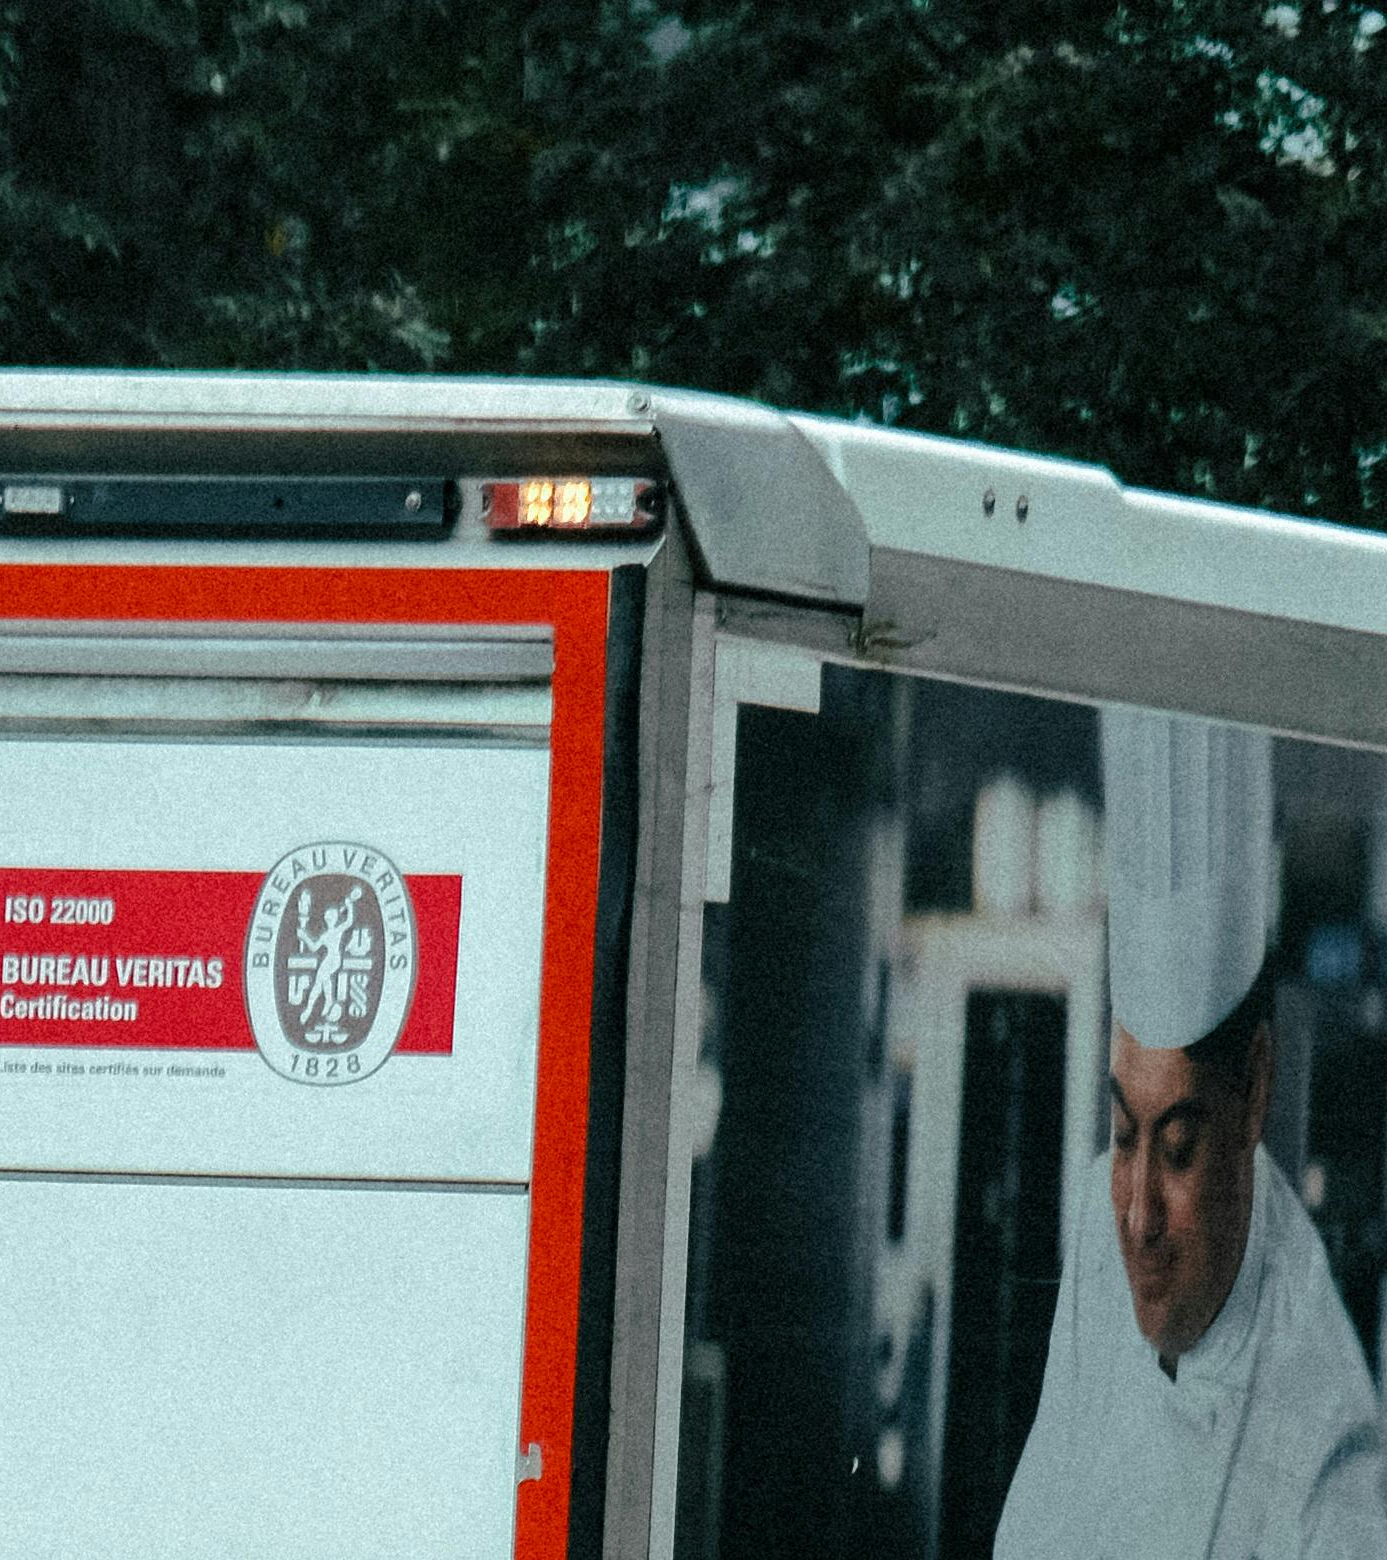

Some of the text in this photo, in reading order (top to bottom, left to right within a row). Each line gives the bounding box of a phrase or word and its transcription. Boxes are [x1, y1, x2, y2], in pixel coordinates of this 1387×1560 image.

[4, 896, 114, 926] ISO 22000
[252, 849, 408, 971] BUREAU VERITAS
[1, 956, 224, 989] BUREAU VERITAS
[0, 994, 137, 1022] Certification
[30, 1061, 53, 1074] des
[290, 1054, 361, 1078] 1828
